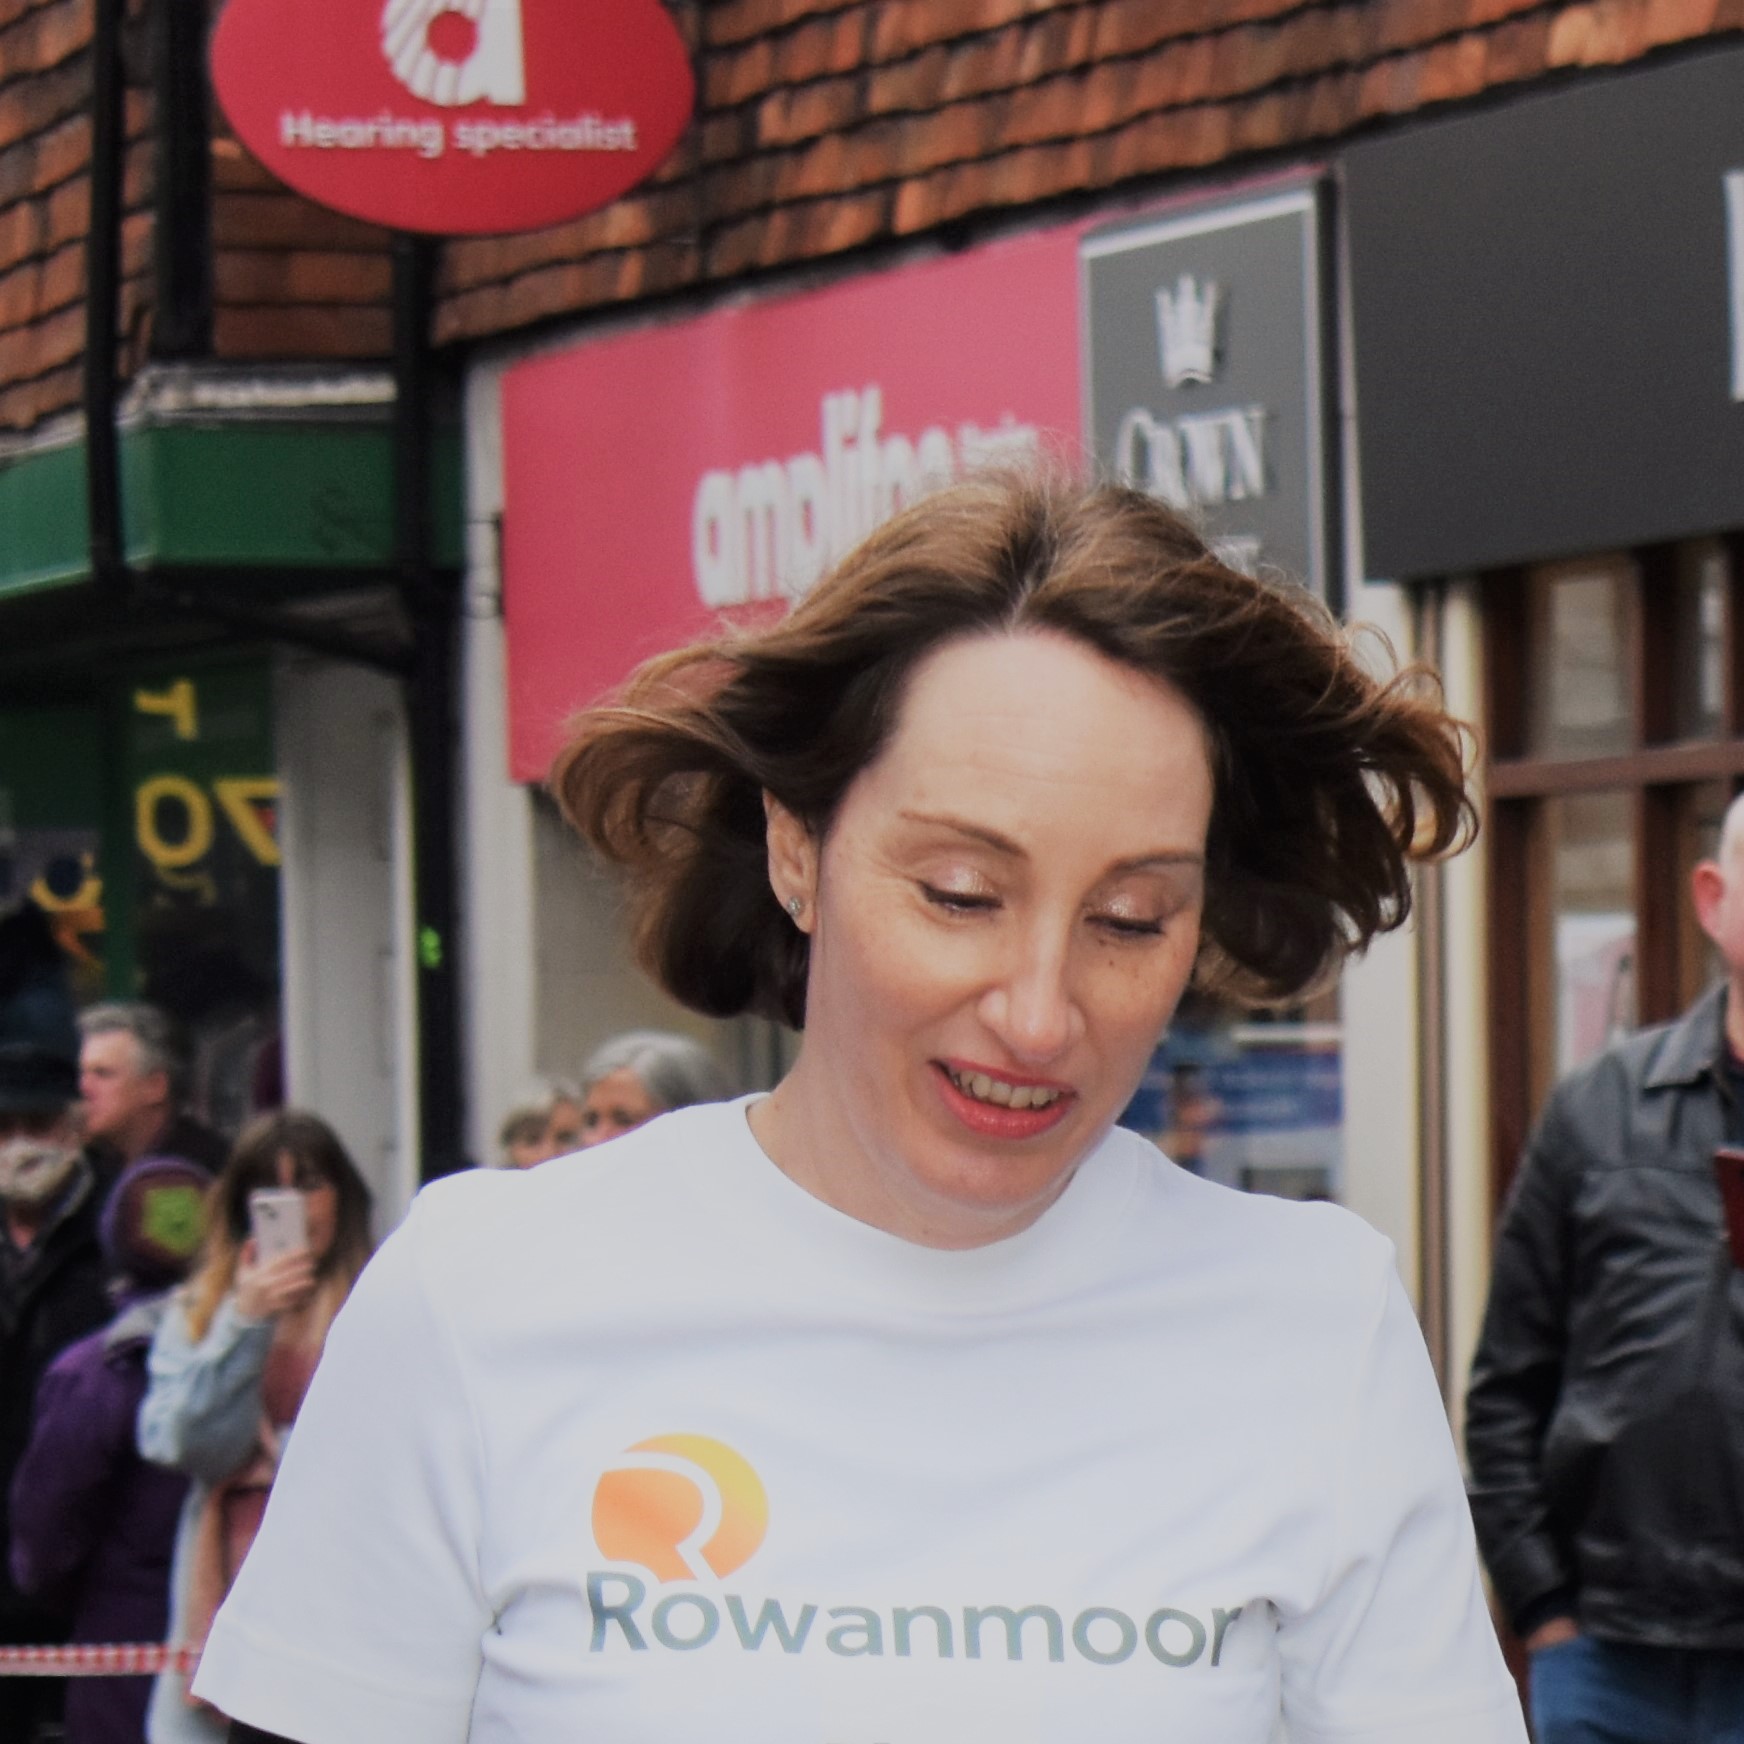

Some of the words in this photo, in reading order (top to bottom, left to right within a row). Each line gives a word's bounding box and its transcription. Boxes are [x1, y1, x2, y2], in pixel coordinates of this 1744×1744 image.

[280, 109, 444, 158] Hearing
[454, 111, 637, 157] specialist
[585, 1570, 1244, 1668] Rowanmoor
